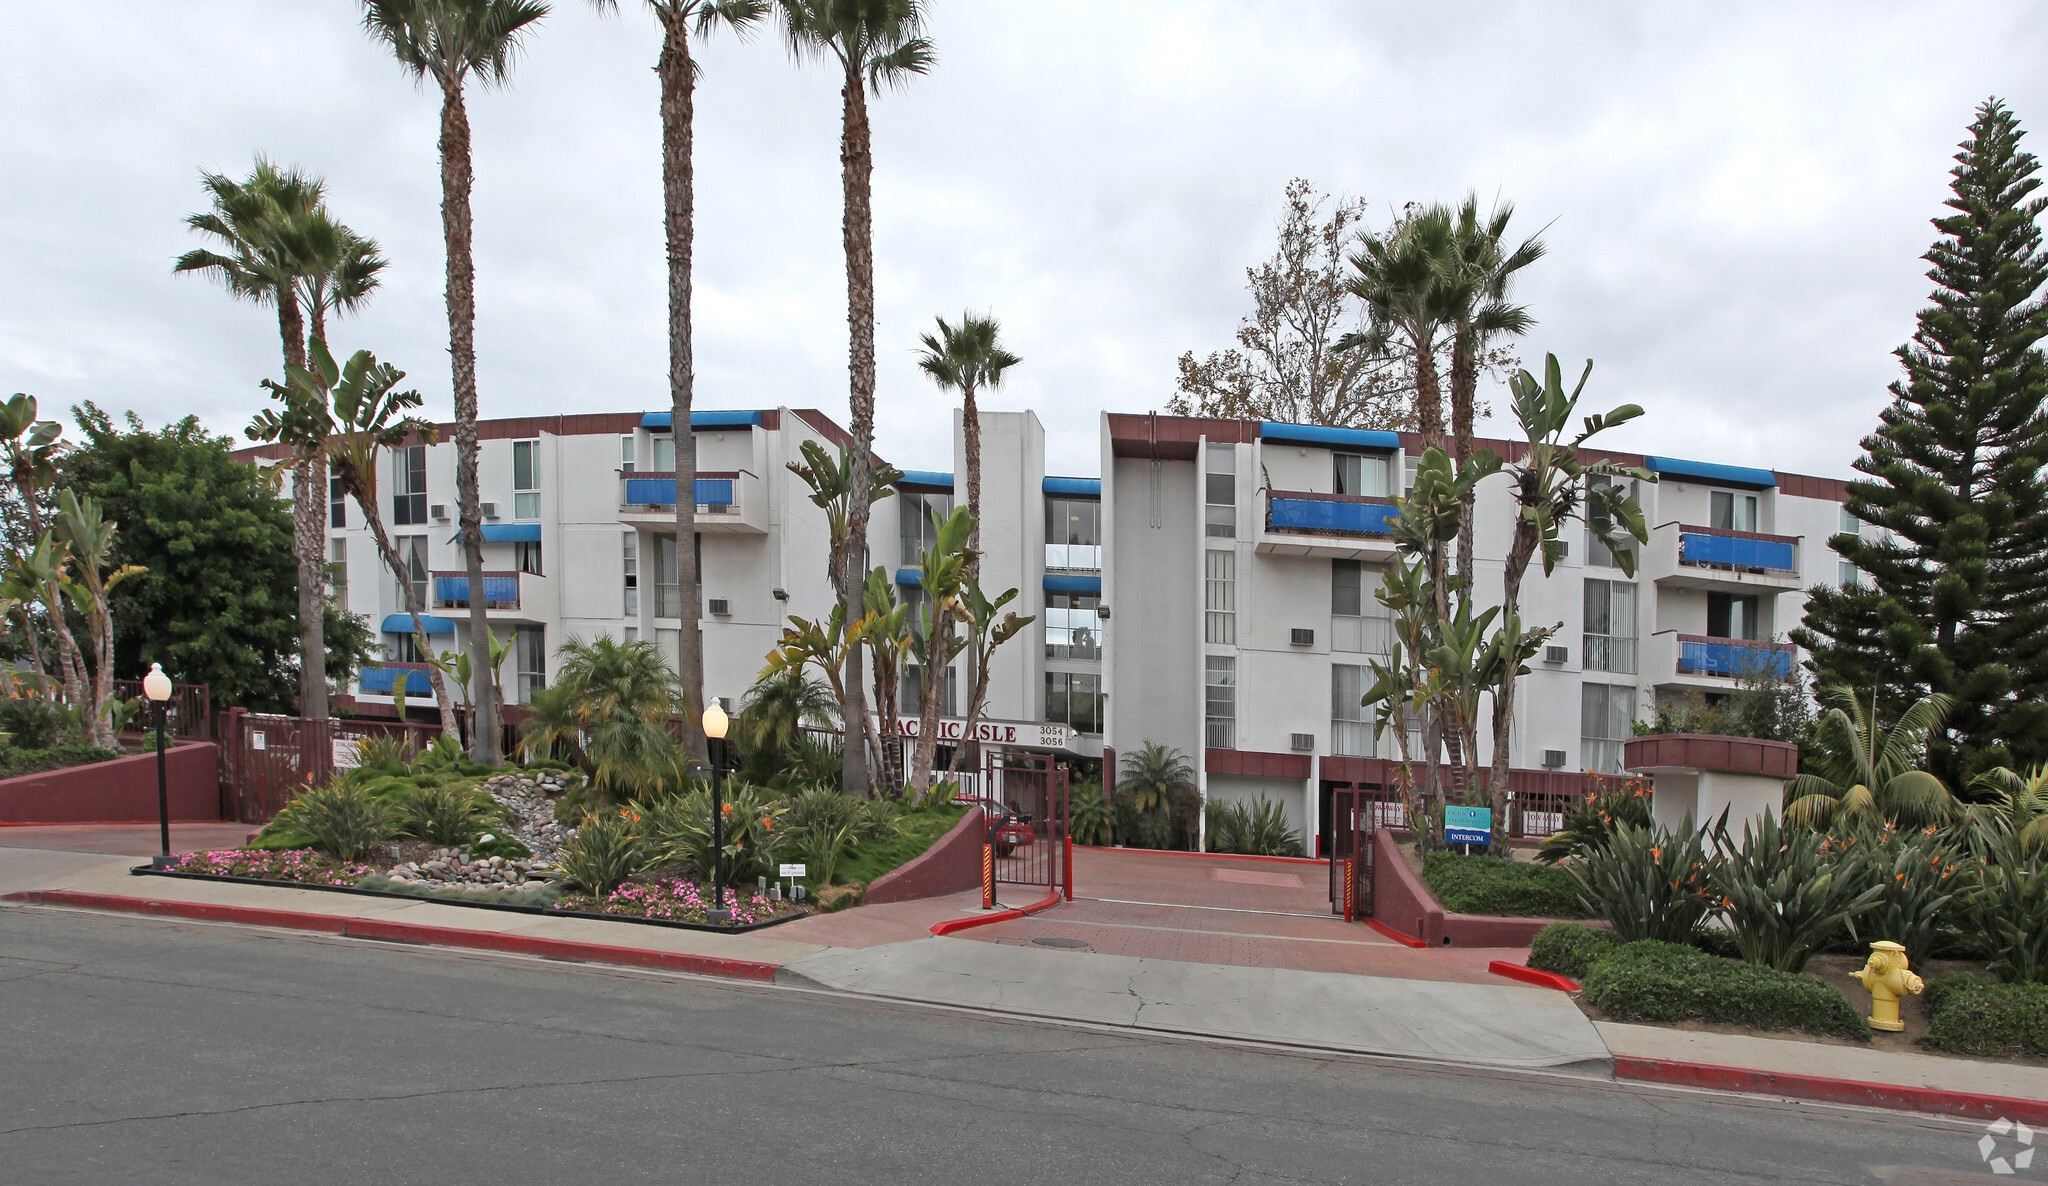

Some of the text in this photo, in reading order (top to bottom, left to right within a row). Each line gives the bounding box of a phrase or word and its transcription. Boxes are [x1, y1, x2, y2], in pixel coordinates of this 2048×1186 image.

[972, 724, 1016, 742] ISLE
[1040, 726, 1063, 735] 3054
[1040, 737, 1063, 745] 3056
[1451, 833, 1484, 842] INTERCOM
